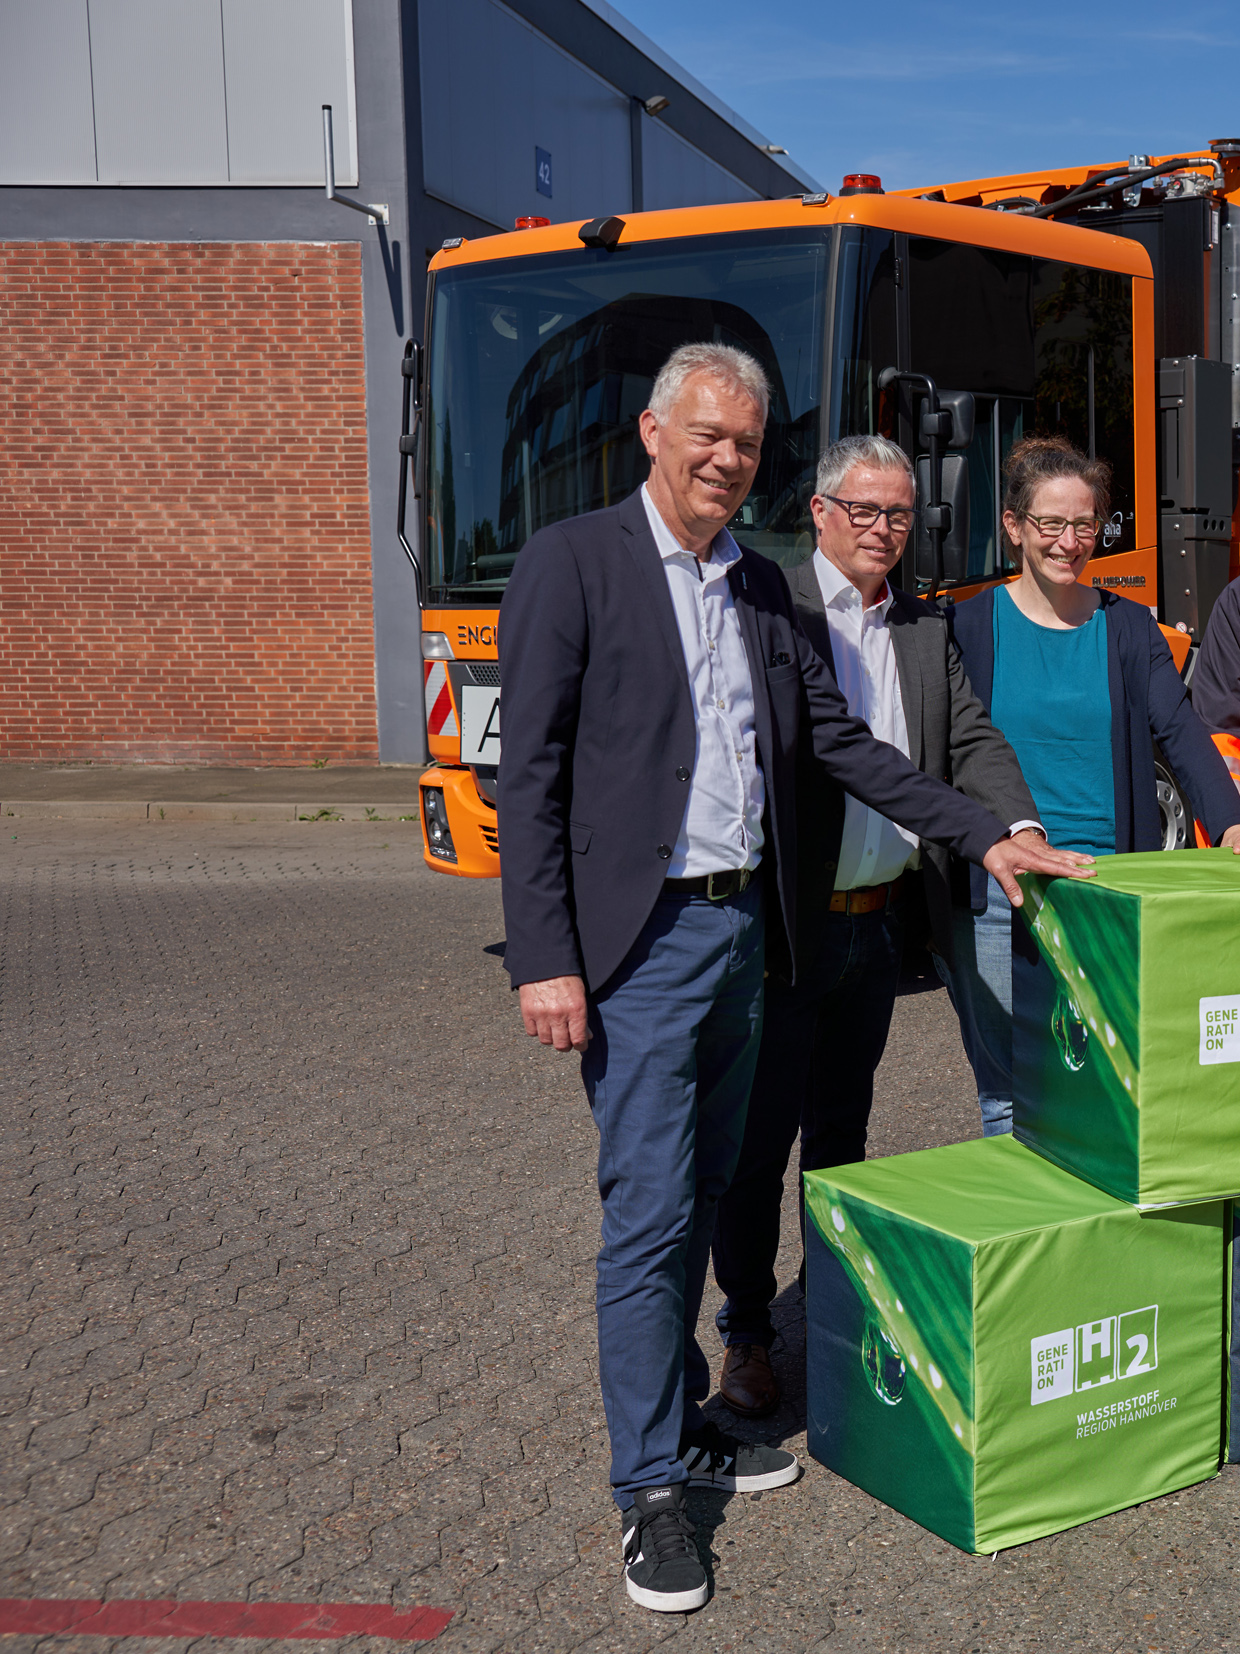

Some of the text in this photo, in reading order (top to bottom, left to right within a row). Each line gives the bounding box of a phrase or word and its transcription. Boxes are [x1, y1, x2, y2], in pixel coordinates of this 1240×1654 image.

[539, 161, 550, 185] 42
[1104, 522, 1121, 535] aha
[1091, 576, 1146, 587] BLUEPOWER
[458, 625, 498, 646] ENGI
[1205, 1009, 1239, 1023] GENE
[1206, 1023, 1235, 1037] RATI
[1206, 1038, 1224, 1050] ON
[1037, 1343, 1069, 1362] GENE
[1037, 1359, 1064, 1377] RATI
[1037, 1376, 1054, 1390] ON
[1076, 1390, 1160, 1426] WASSERSTOFF
[1075, 1397, 1178, 1439] REGION HANNOVER
[649, 1491, 670, 1500] adidas
